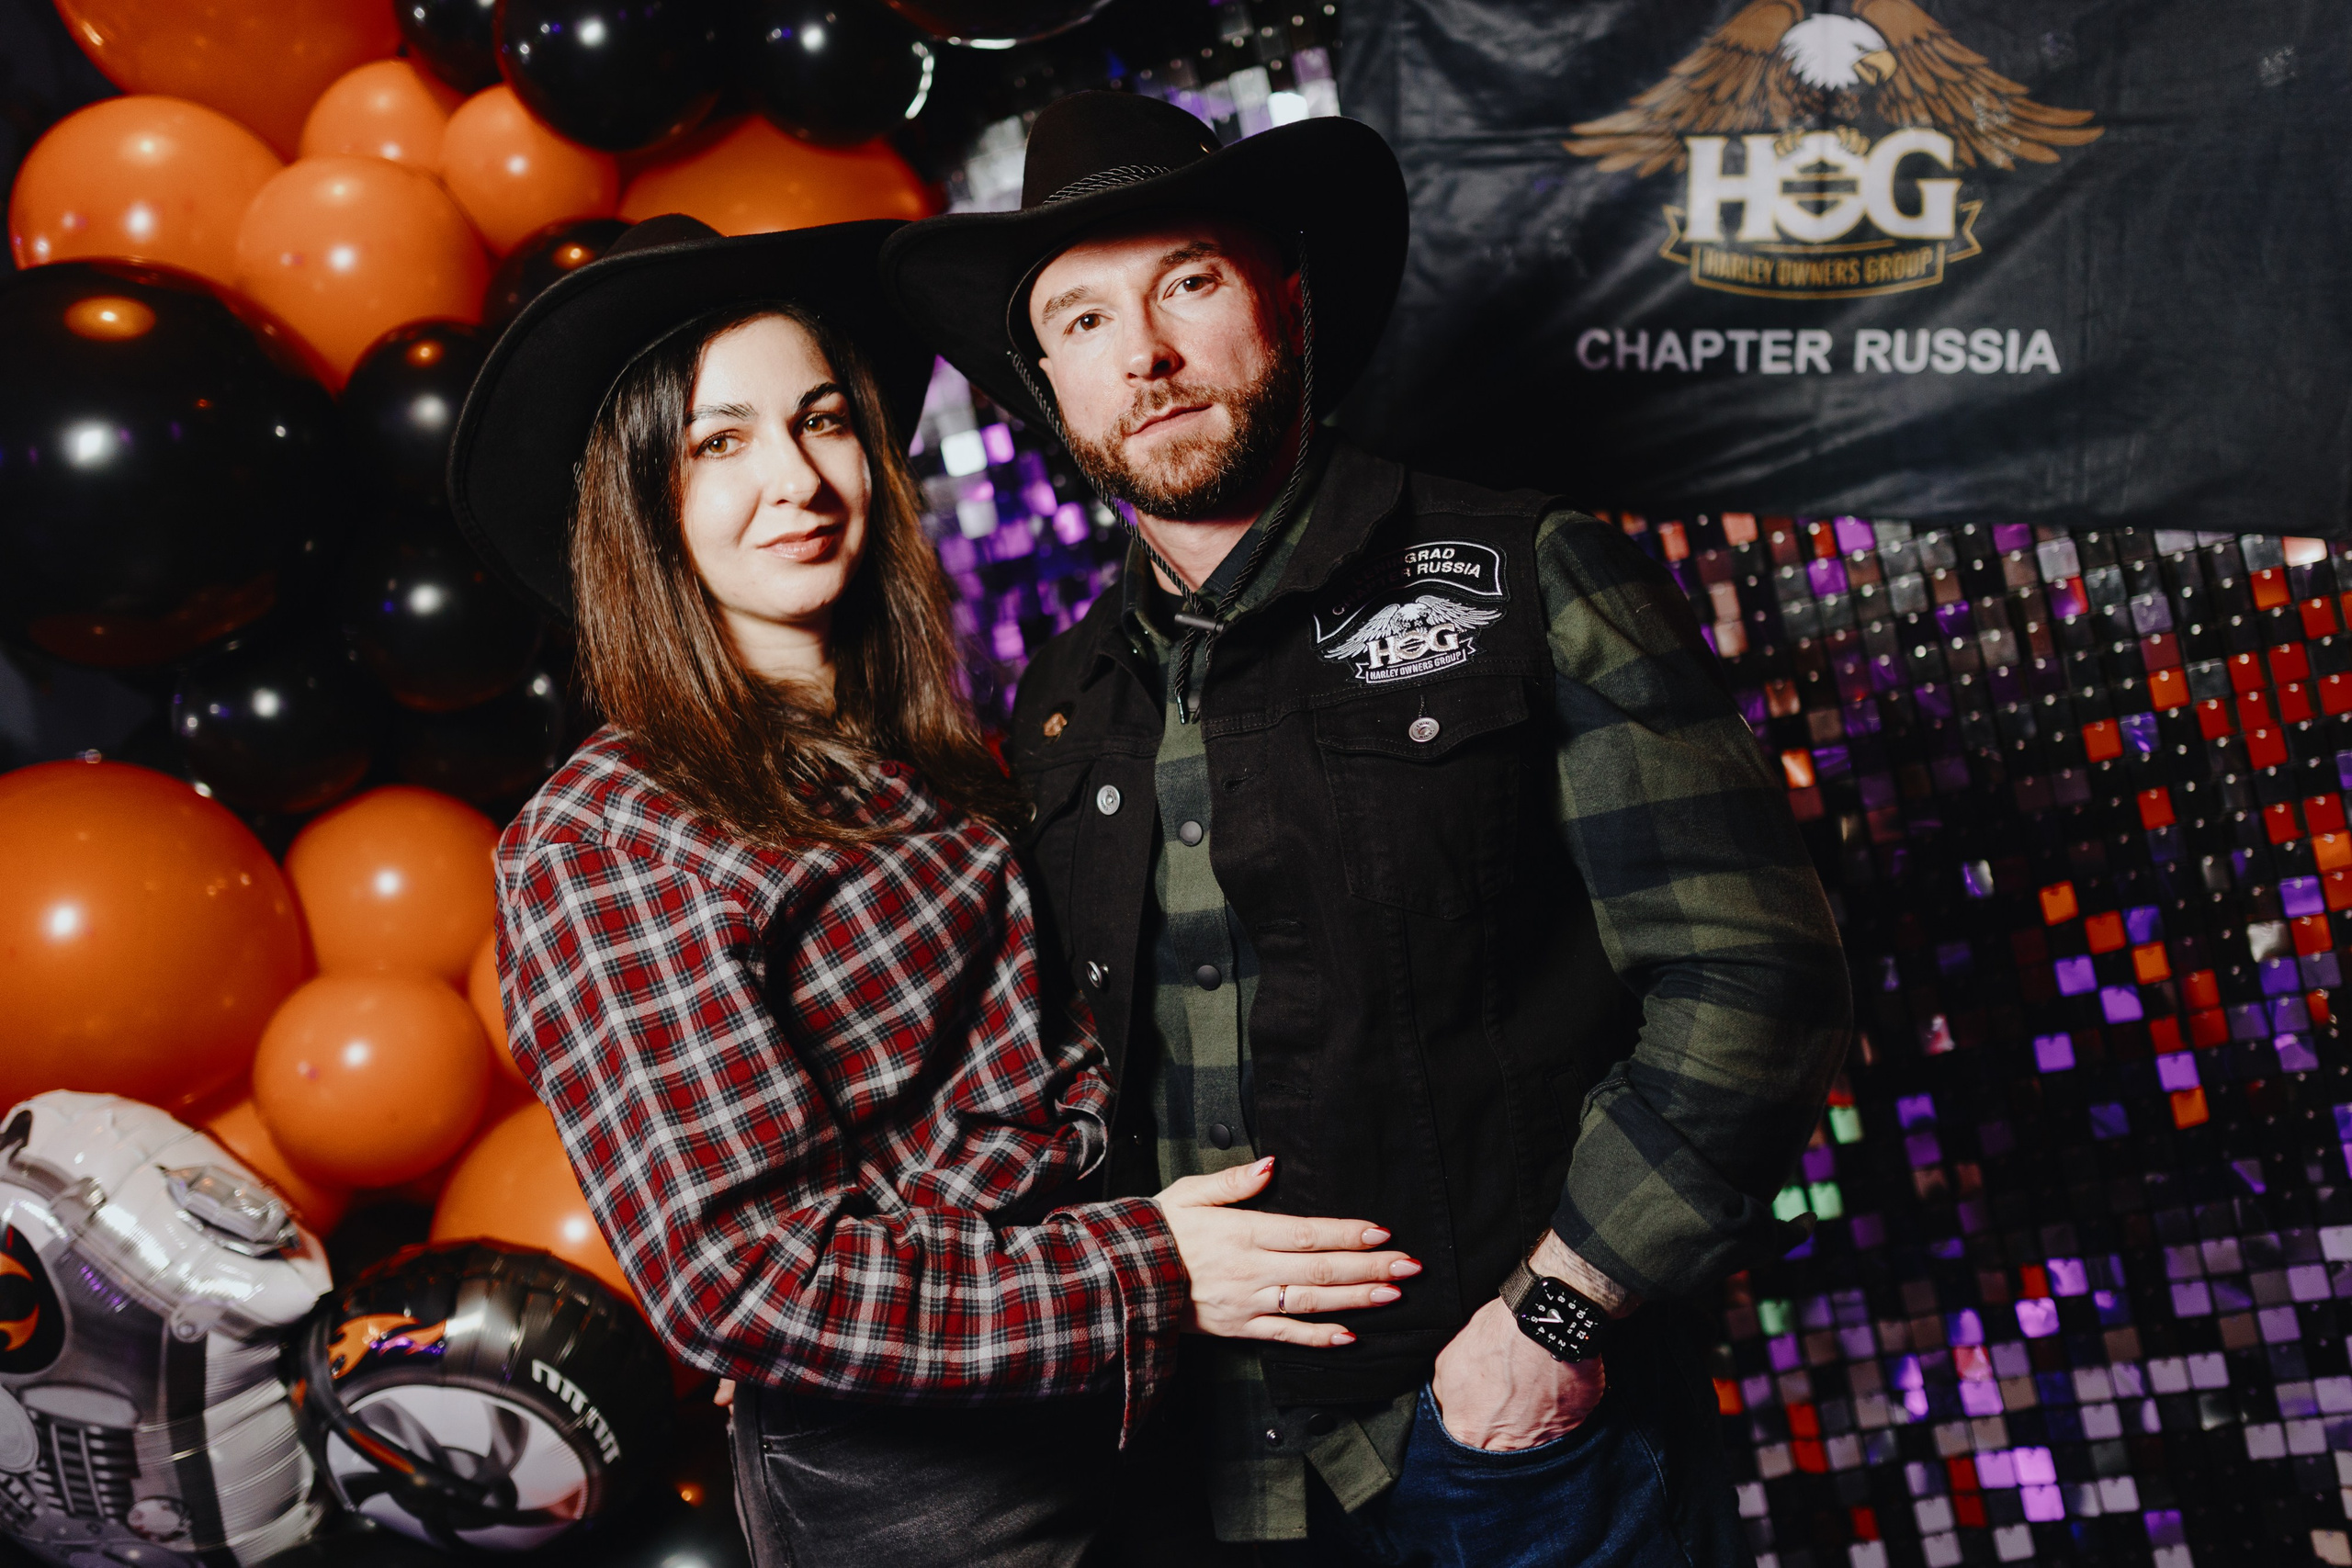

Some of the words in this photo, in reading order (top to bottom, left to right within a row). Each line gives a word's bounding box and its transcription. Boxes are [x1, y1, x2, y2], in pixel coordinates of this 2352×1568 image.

[1682, 128, 1962, 243] HOG
[1702, 247, 1775, 286] HARLEY
[1777, 256, 1861, 288] OWNERS
[1863, 245, 1933, 283] GROUP
[1577, 329, 1832, 373] CHAPTER
[1854, 329, 2062, 374] RUSSIA
[1417, 560, 1481, 579] RUSSIA
[1366, 623, 1459, 670] HOG
[1370, 667, 1399, 681] HARLEY
[1399, 661, 1433, 676] OWNERS
[1433, 650, 1462, 667] GROUP
[1577, 1310, 1586, 1319] 10
[1577, 1331, 1586, 1339] 12
